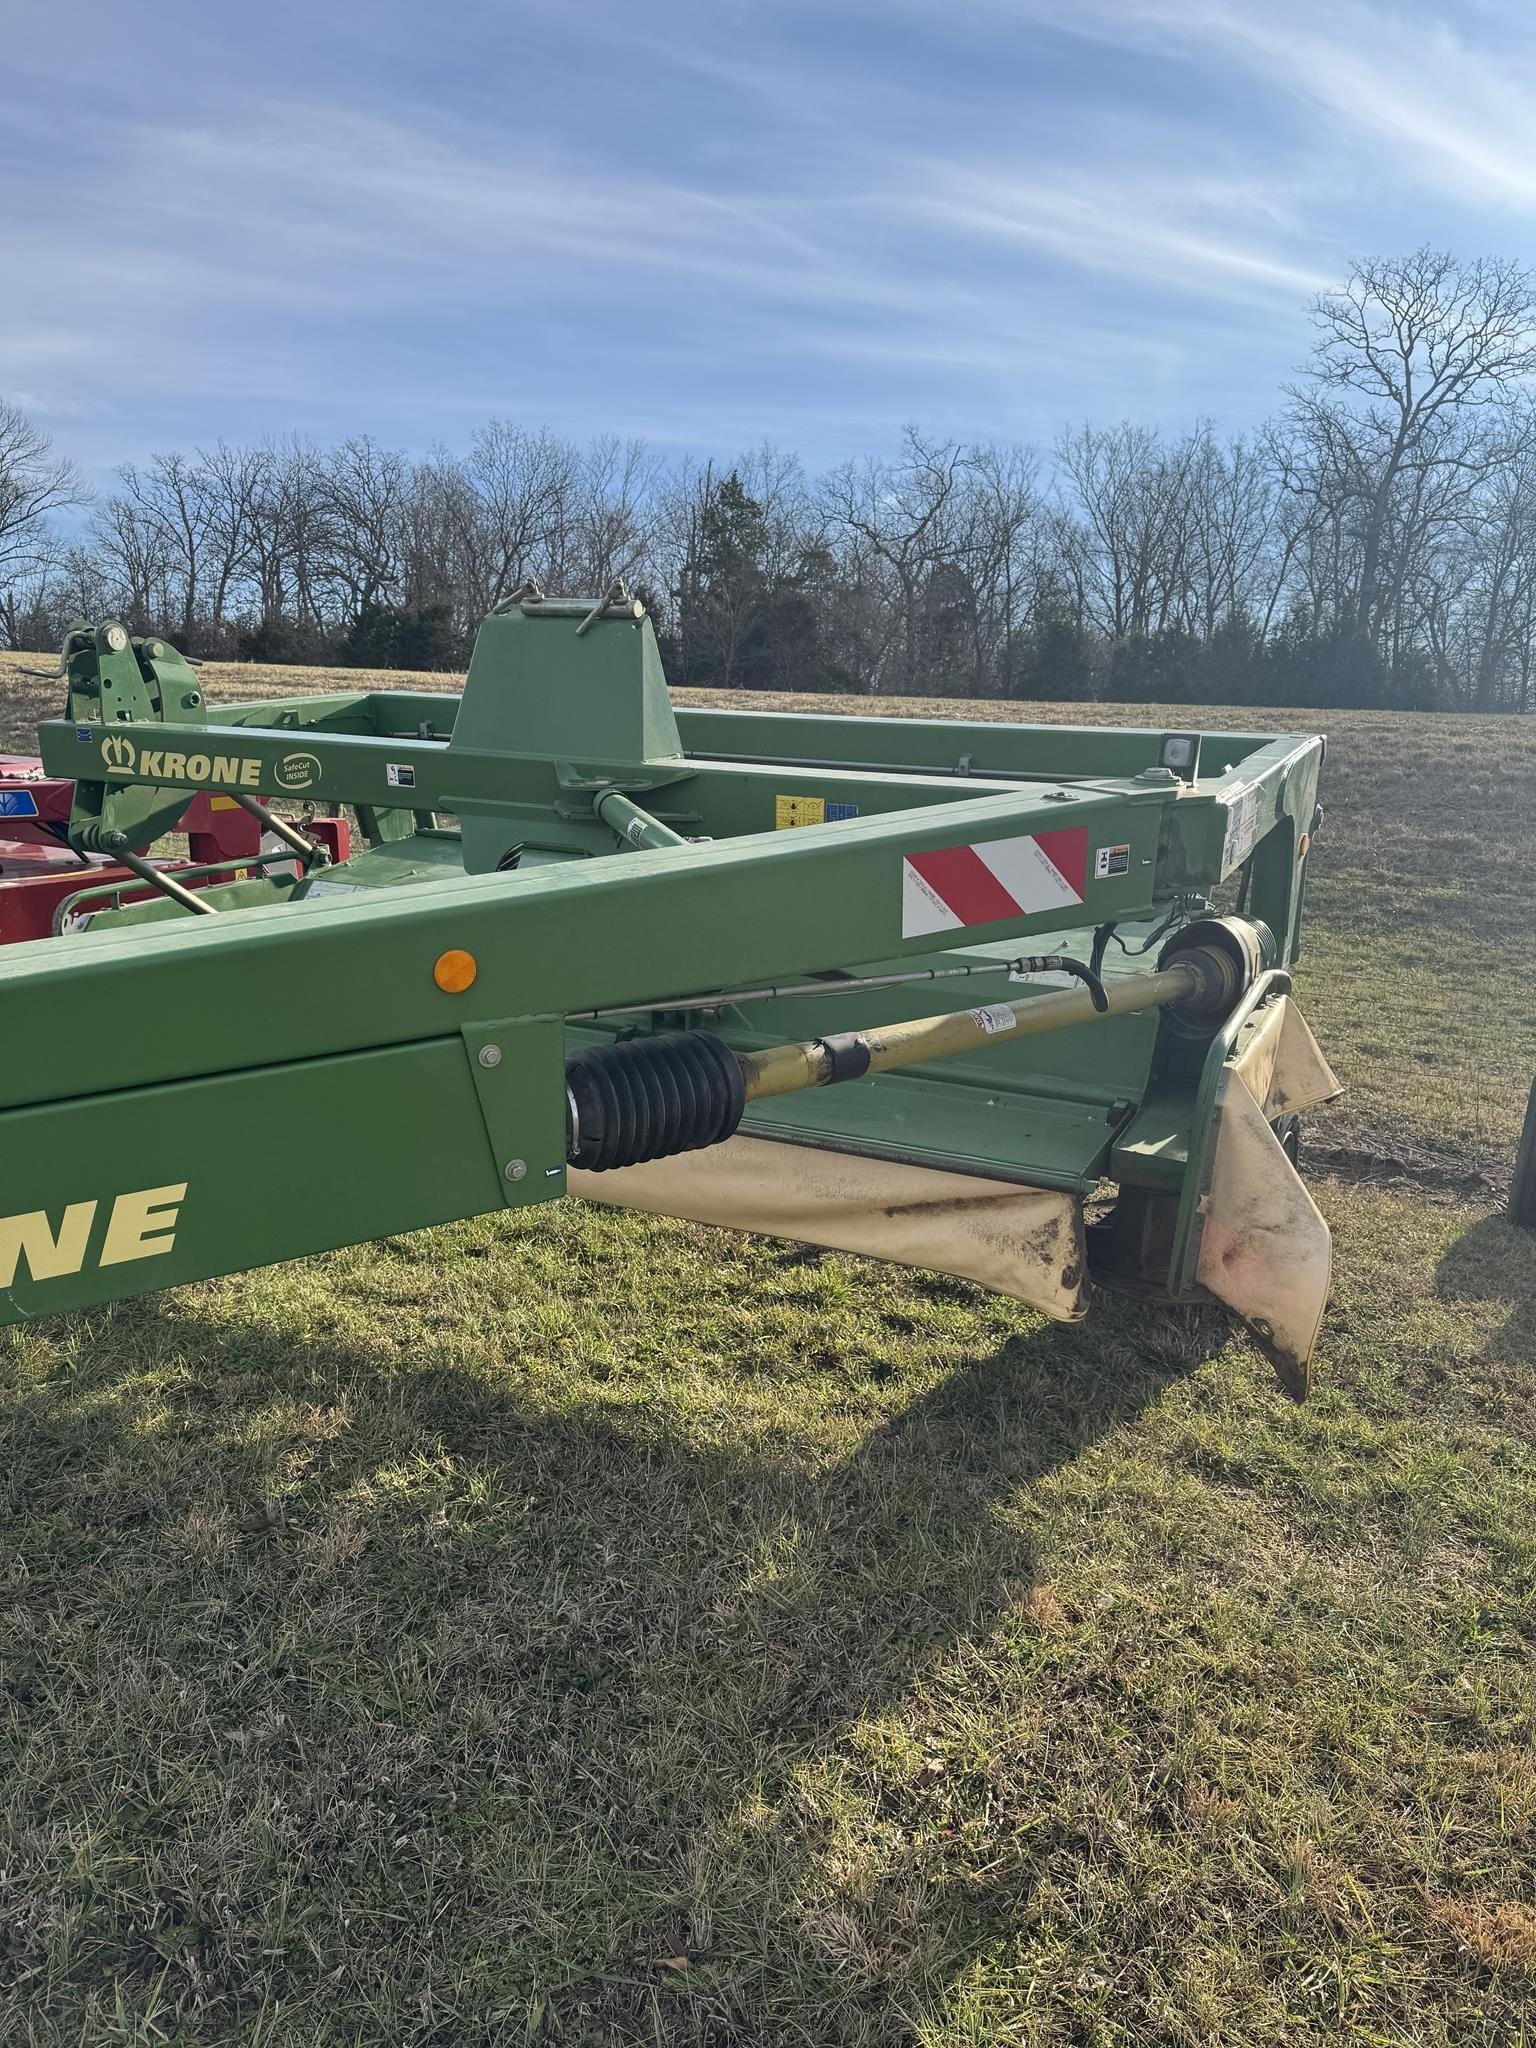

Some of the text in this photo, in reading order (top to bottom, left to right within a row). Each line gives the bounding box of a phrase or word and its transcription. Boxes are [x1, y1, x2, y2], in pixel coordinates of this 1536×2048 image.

[139, 750, 262, 786] KRONE
[283, 761, 310, 772] SafeCut
[286, 770, 309, 780] INSIDE
[0, 1182, 188, 1289] NE
